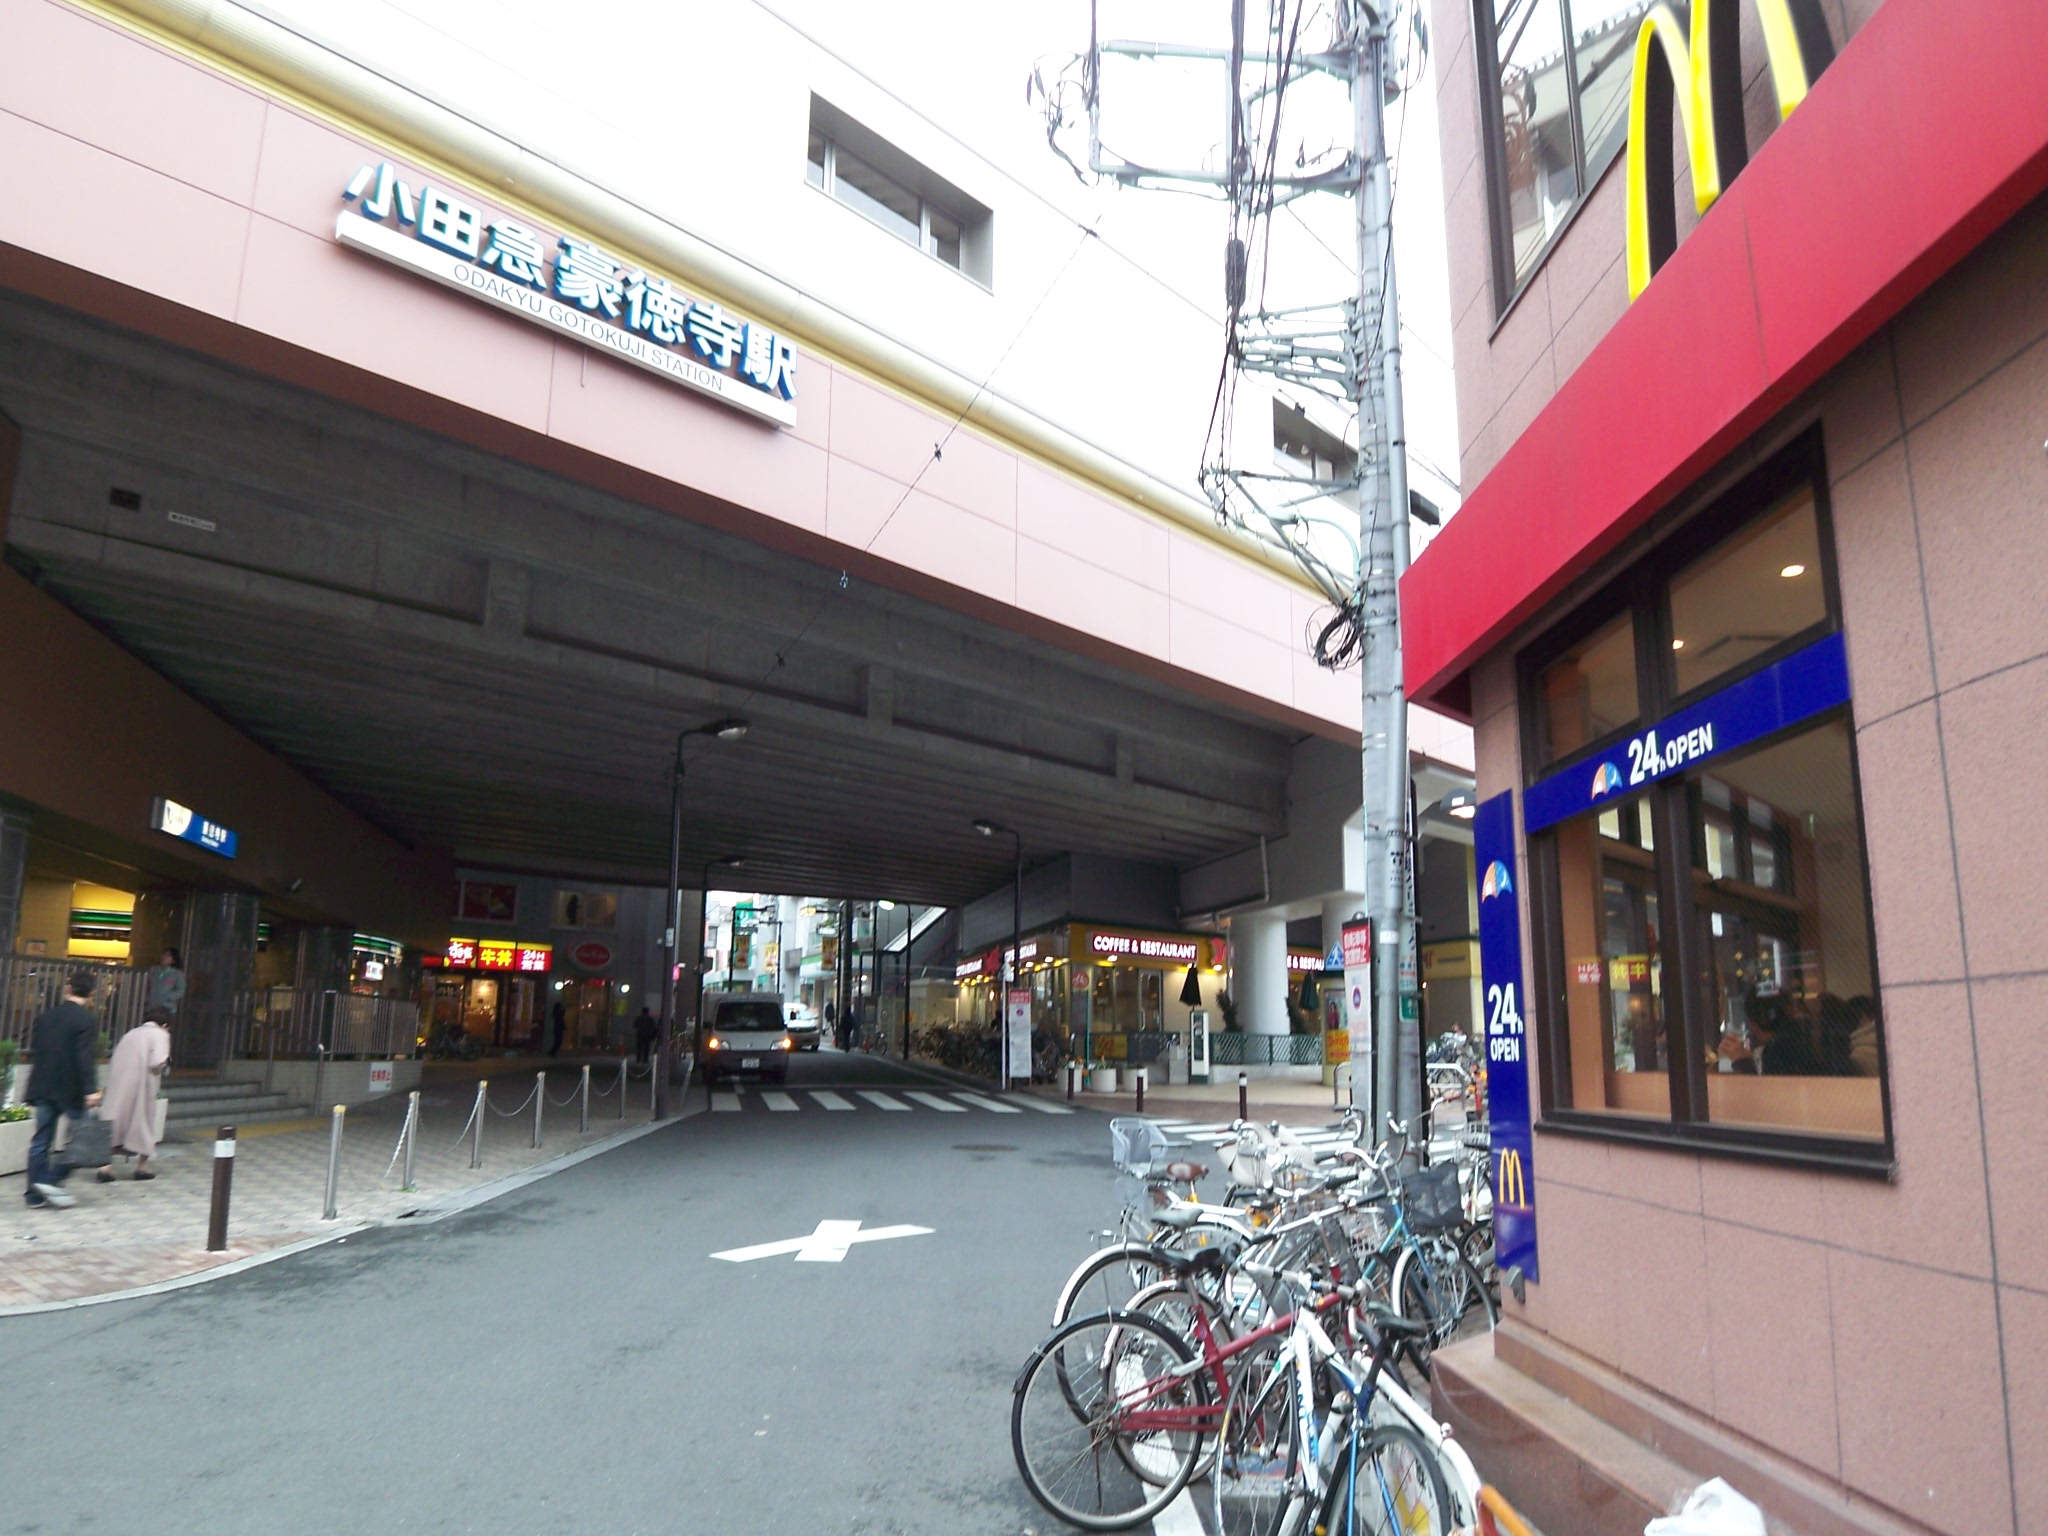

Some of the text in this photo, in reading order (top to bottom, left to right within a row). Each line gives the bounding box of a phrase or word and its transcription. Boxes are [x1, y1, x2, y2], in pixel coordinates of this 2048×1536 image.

[342, 162, 799, 402] 小田急豪徳寺駅
[453, 264, 723, 392] ODAKYU GOTOKUJI STATION
[1628, 722, 1713, 786] 24h OPEN
[480, 948, 512, 966] 牛丼
[523, 949, 546, 961] 24H
[1093, 935, 1197, 960] COFFEE & RESTAURANT
[1299, 956, 1325, 972] RESTAU
[1488, 982, 1524, 1035] 24h
[1490, 1036, 1520, 1062] OPEN
